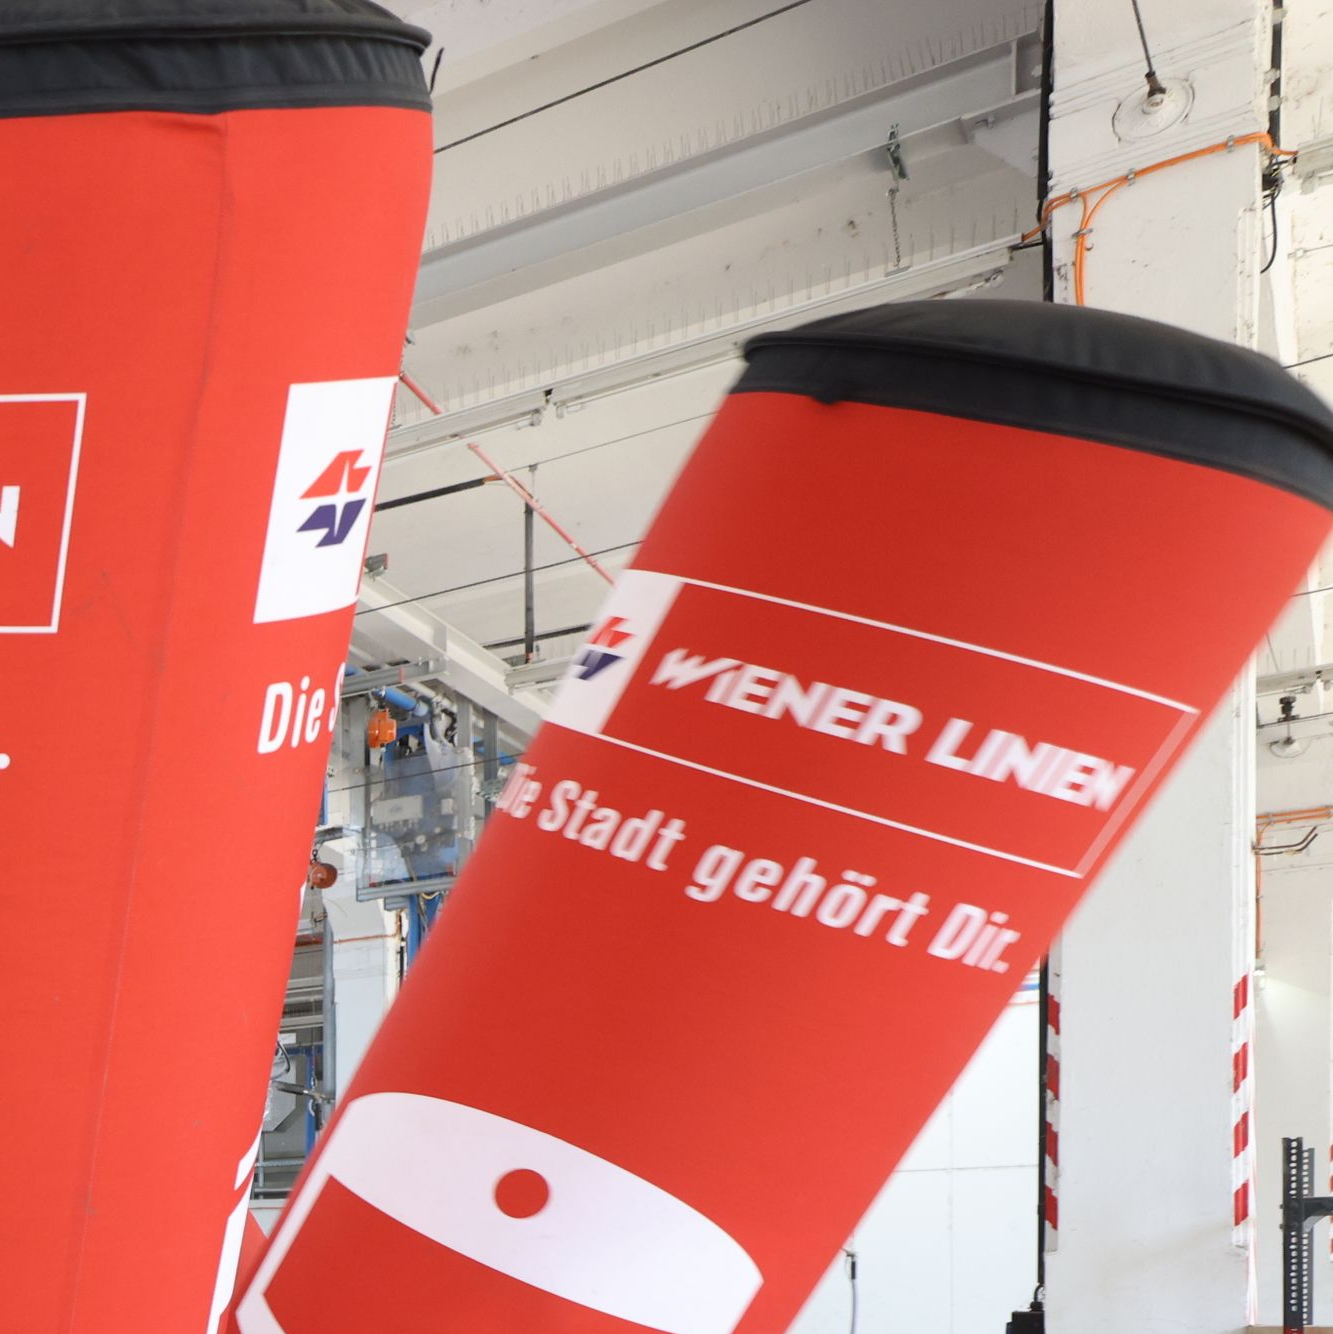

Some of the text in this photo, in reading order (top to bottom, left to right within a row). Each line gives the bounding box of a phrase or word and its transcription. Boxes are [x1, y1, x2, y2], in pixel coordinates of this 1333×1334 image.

[256, 675, 326, 755] Die
[647, 645, 1136, 812] WIENER LINIEN
[536, 778, 686, 873] Stadt
[683, 843, 931, 949] gehört
[927, 901, 1022, 974] Dir.
